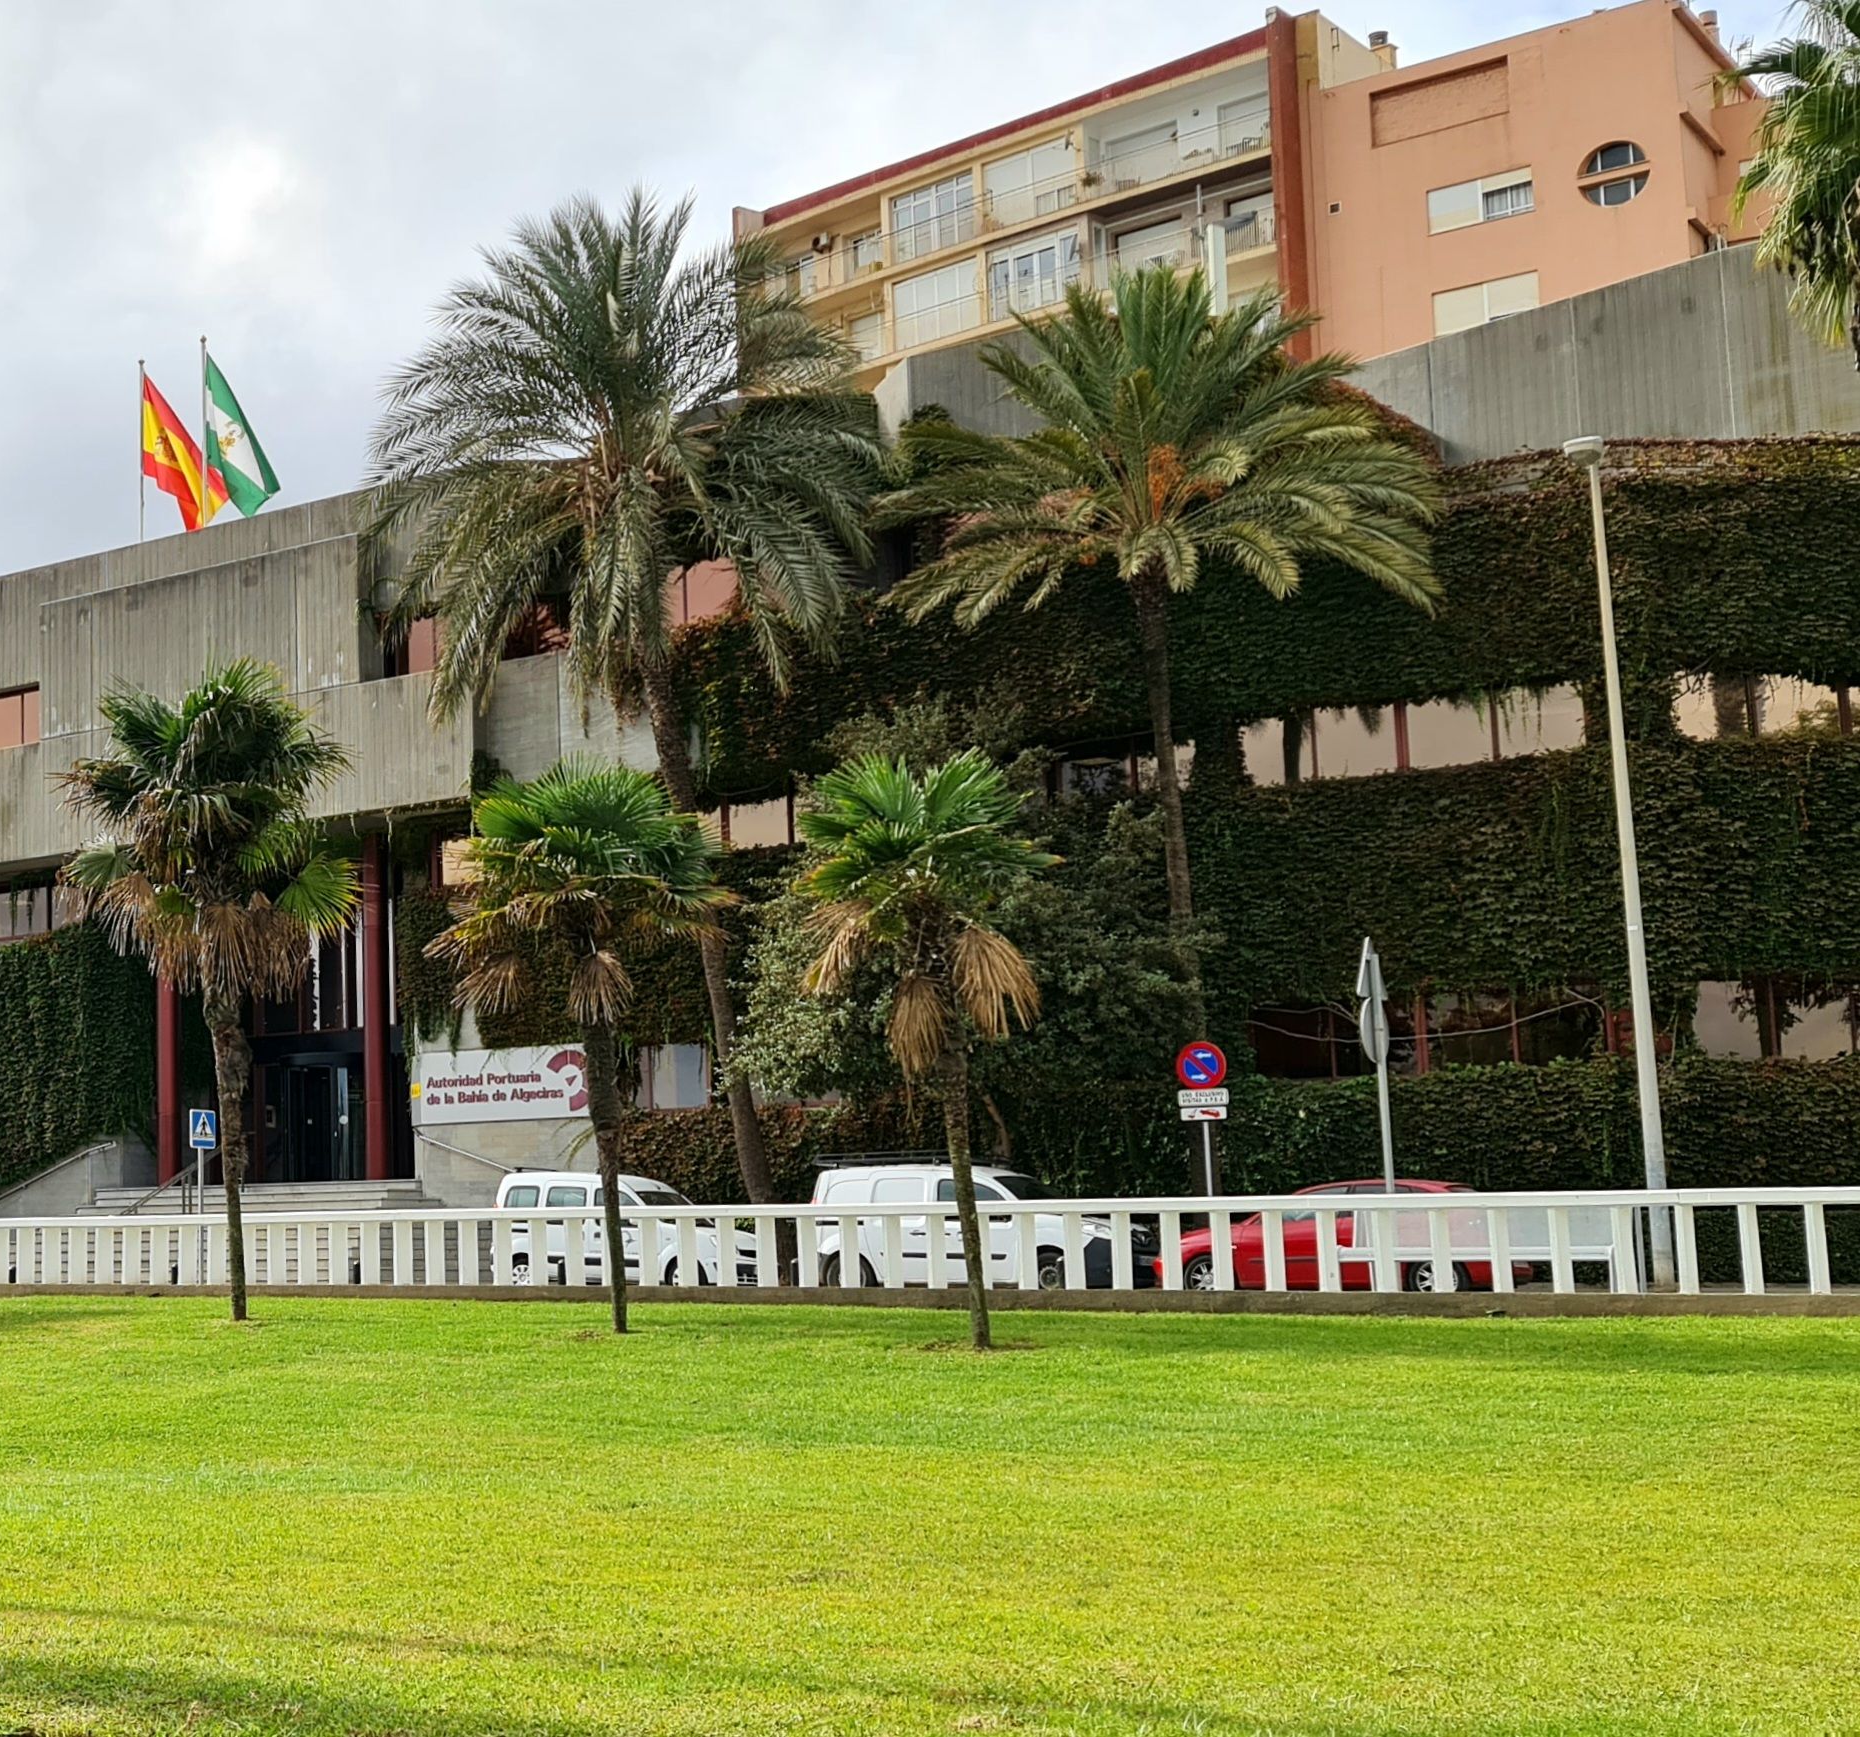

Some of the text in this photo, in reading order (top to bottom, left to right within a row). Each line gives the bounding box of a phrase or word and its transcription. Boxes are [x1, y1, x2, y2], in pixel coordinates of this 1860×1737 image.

[426, 1071, 541, 1089] Autoridad Portuaria
[426, 1087, 564, 1105] de la Bahía de Algeciras
